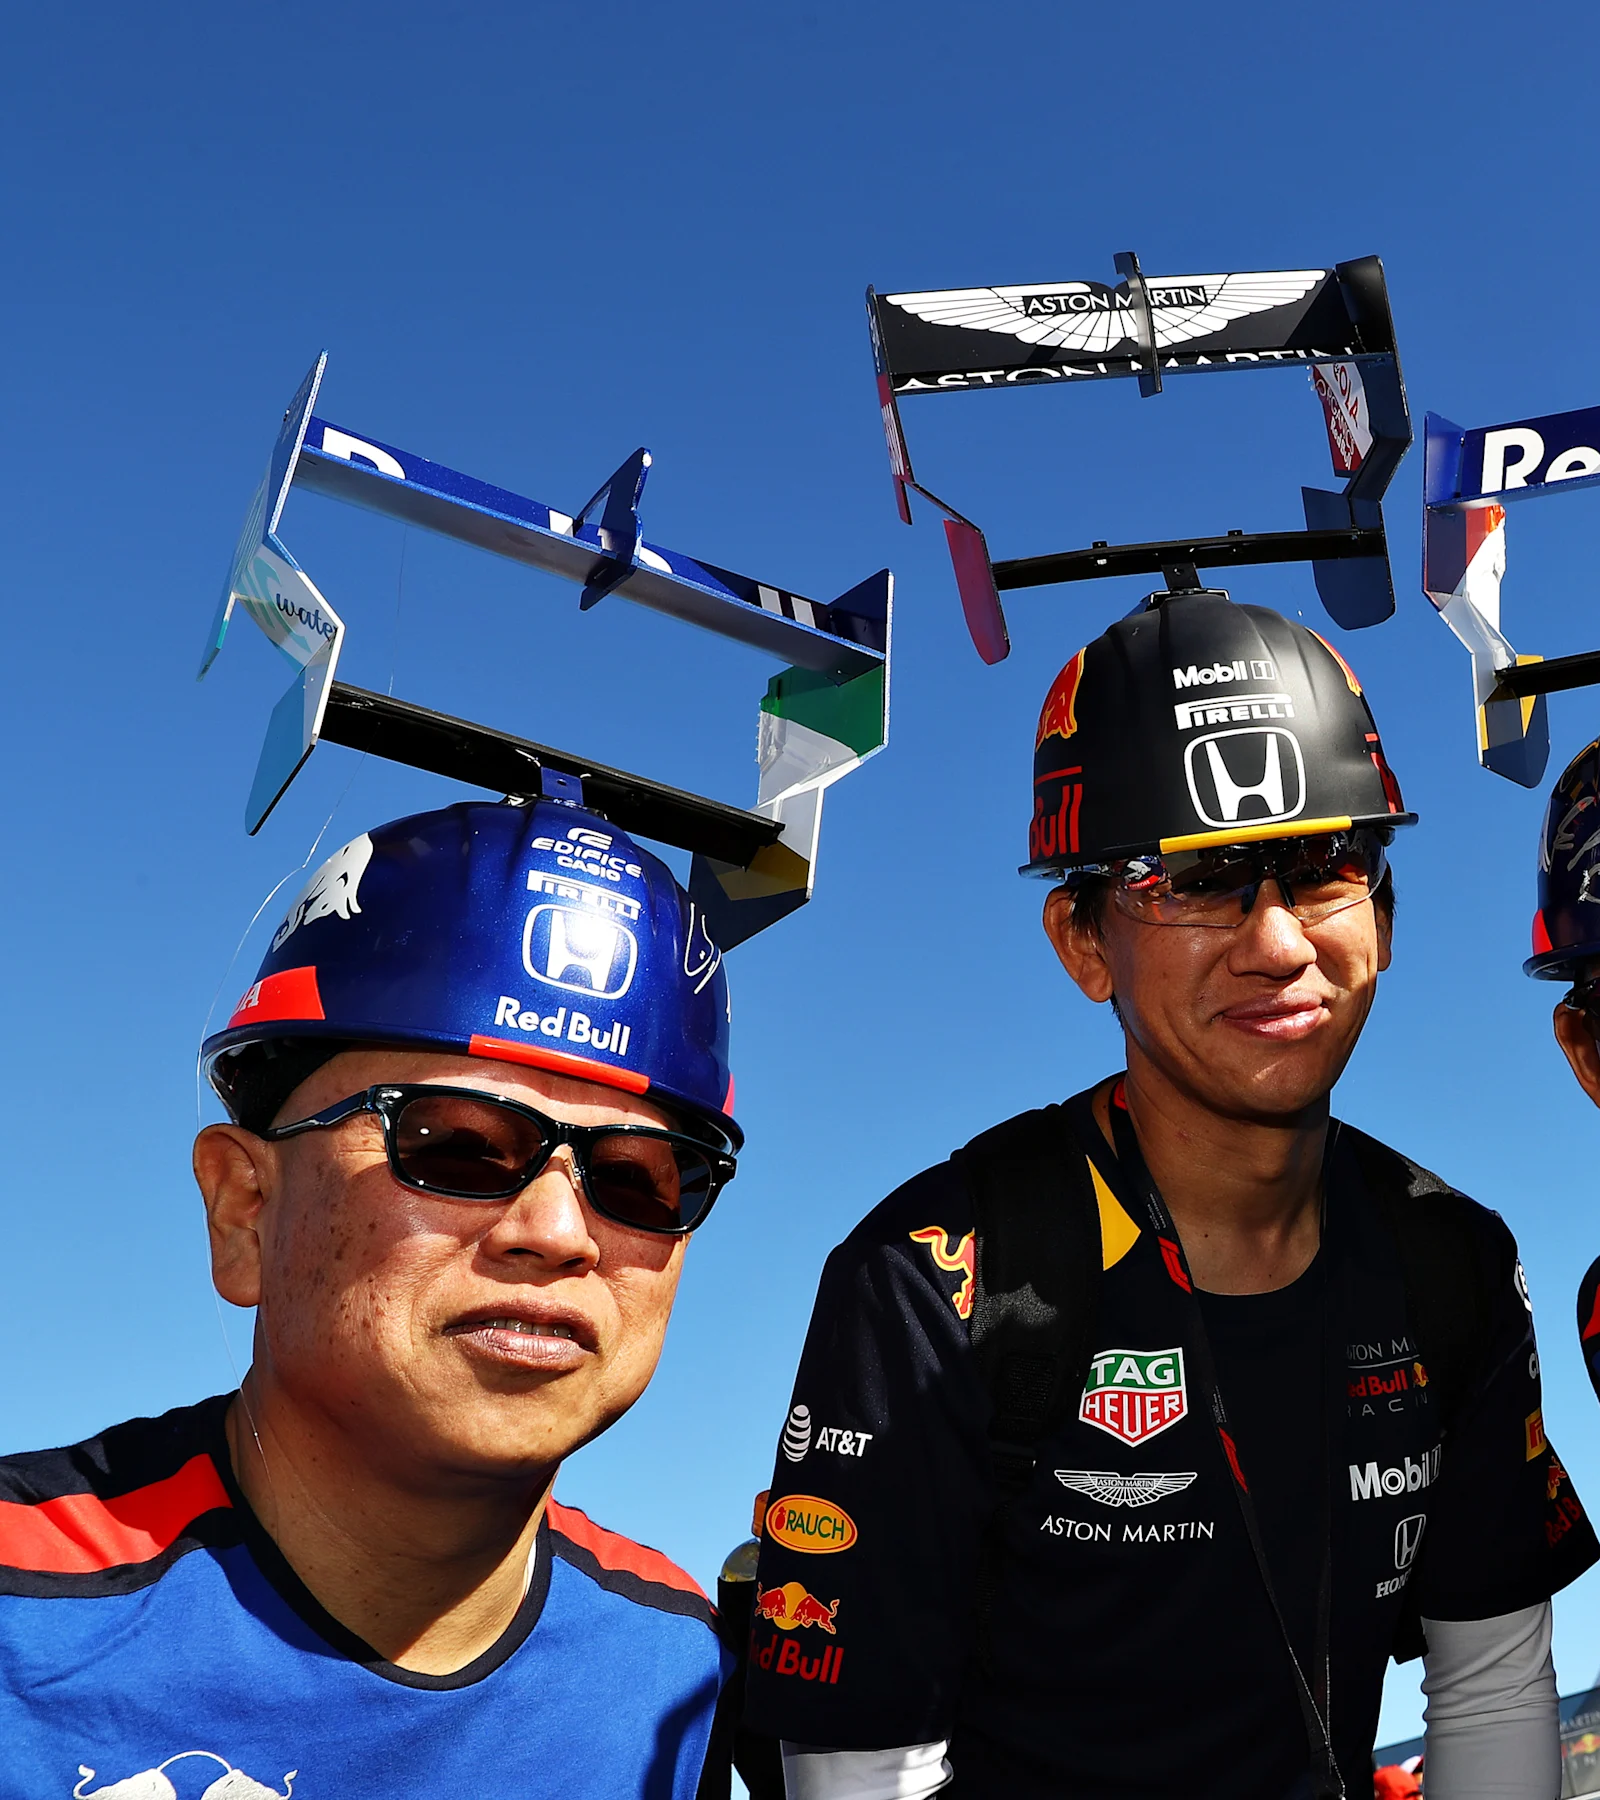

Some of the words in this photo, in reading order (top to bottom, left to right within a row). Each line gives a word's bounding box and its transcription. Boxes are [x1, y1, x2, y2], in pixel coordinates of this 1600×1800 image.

[1028, 293, 1110, 314] ASTON
[1173, 661, 1248, 689] Mobil
[1174, 694, 1295, 730] PIRELLI
[531, 837, 643, 879] EDIFICE
[556, 855, 622, 882] CASIO
[528, 870, 642, 920] PIRELLI
[494, 995, 568, 1039] Red
[567, 1014, 631, 1056] Bull
[1092, 1355, 1175, 1387] TAG
[1367, 1369, 1408, 1396] Bull
[1084, 1393, 1182, 1445] HEUER
[815, 1427, 873, 1458] AT&T
[1097, 1479, 1124, 1487] ASTON
[1125, 1479, 1154, 1487] MARTIN
[1349, 1451, 1430, 1501] Mobil
[787, 1509, 846, 1542] RAUCH
[1040, 1515, 1112, 1542] ASTON
[1122, 1521, 1214, 1543] MARTIN
[776, 1638, 845, 1684] Bull
